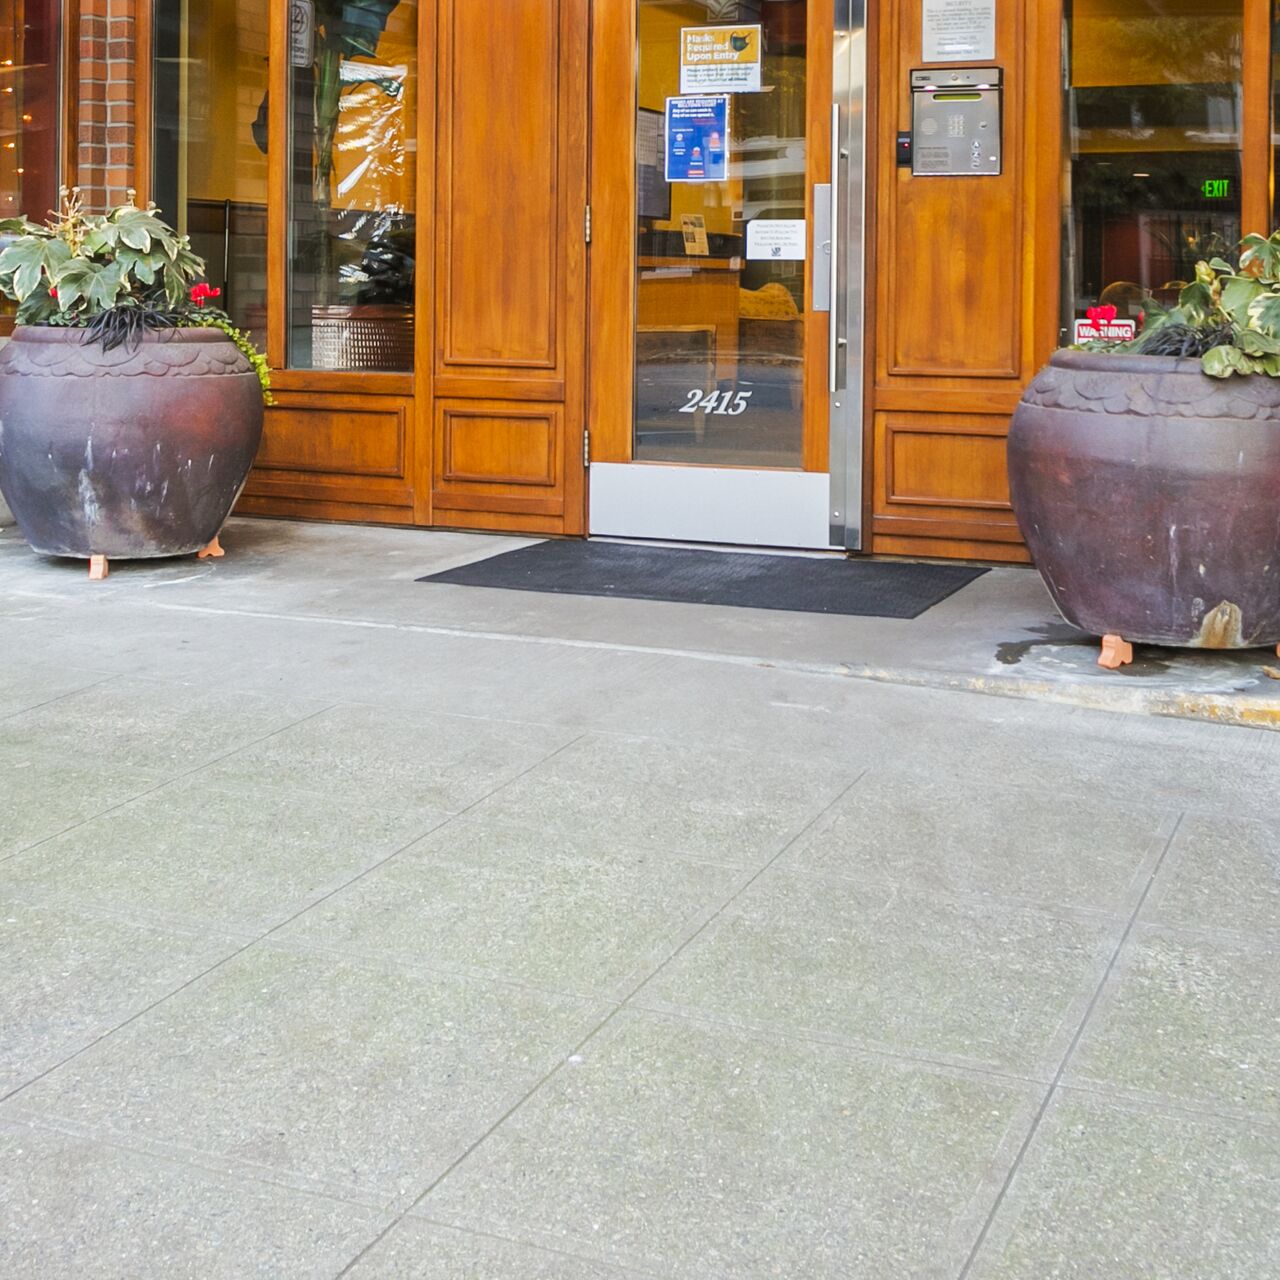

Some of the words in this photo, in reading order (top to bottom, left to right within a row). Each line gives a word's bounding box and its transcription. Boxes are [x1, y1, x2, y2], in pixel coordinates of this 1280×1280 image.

[687, 52, 712, 62] Upon
[713, 51, 739, 61] Entry
[1205, 180, 1229, 197] EXIT
[678, 388, 753, 416] 2415
